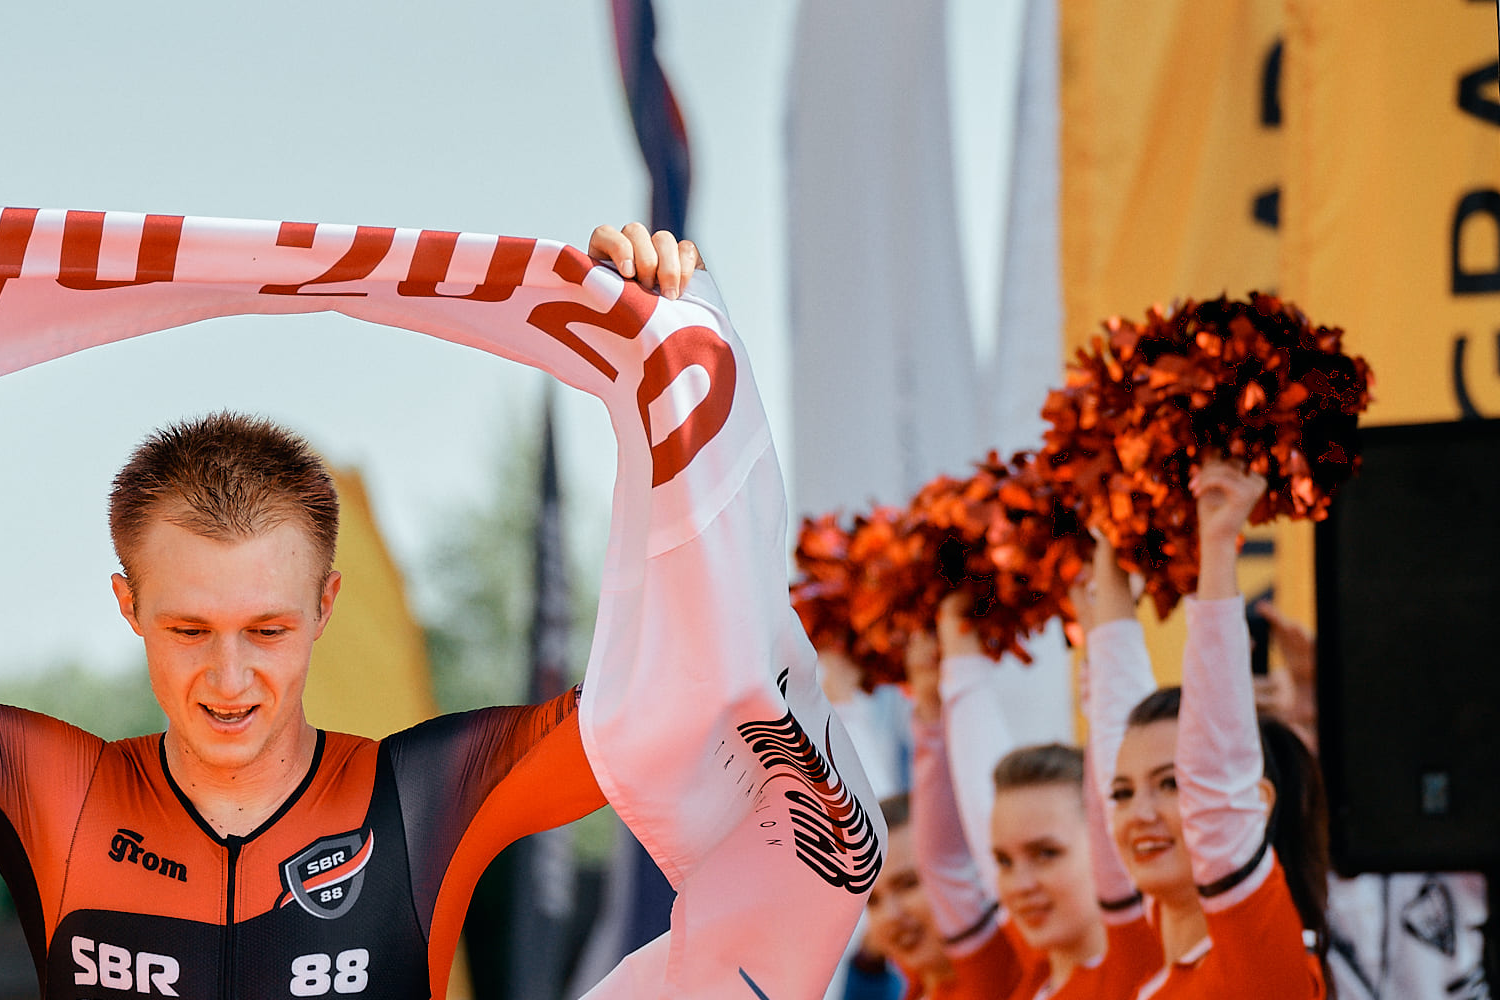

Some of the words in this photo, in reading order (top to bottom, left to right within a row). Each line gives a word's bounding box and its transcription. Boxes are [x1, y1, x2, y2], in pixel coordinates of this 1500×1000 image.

[108, 828, 188, 882] grom
[306, 849, 346, 876] SBR
[319, 886, 344, 903] 88
[71, 935, 180, 998] SBR
[290, 948, 370, 996] 88
